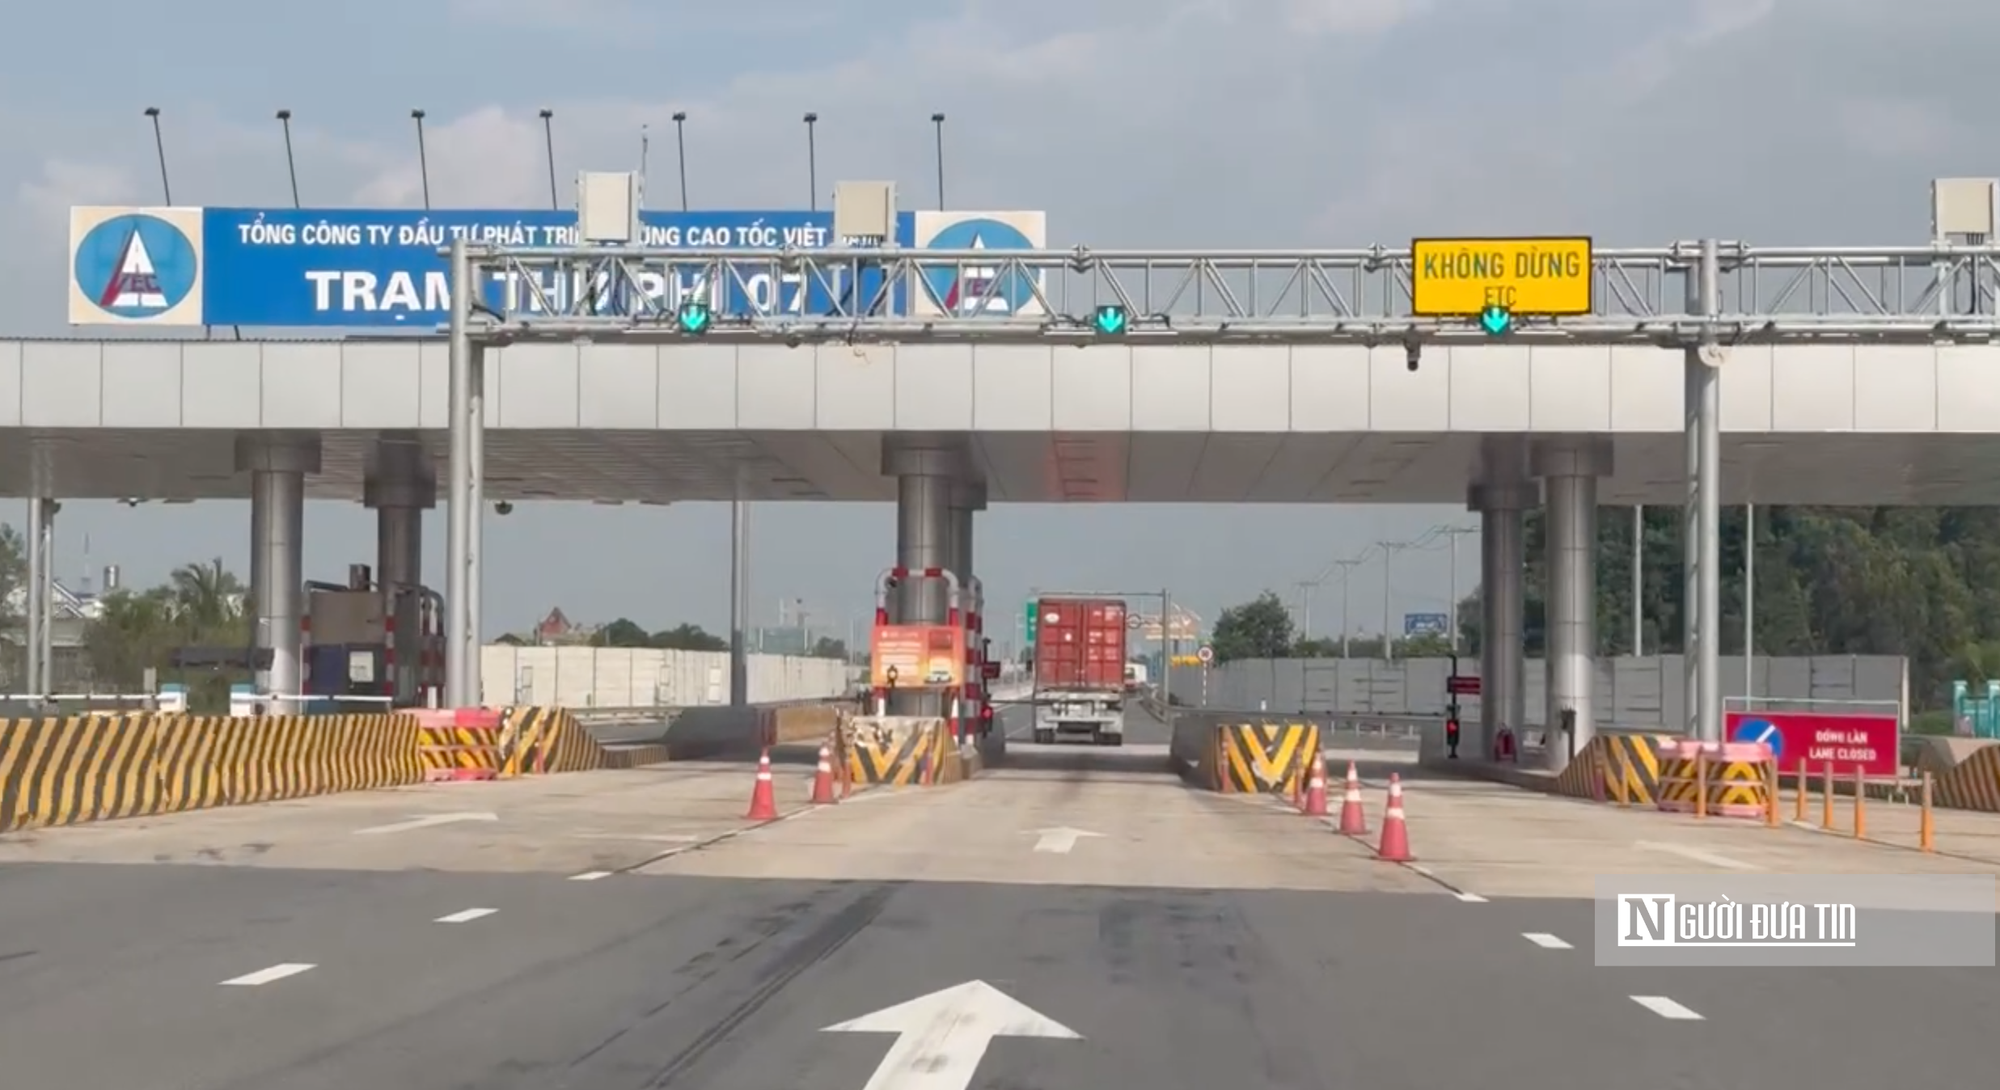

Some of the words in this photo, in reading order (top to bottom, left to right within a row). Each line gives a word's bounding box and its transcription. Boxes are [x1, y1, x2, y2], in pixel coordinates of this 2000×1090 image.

[238, 212, 296, 244] TỔNG
[302, 219, 361, 245] CÔNG
[367, 225, 394, 245] TY
[399, 216, 444, 245] ĐẦU
[484, 220, 538, 244] PHÁT
[686, 226, 731, 246] CAO
[736, 218, 777, 247] TỐC
[1423, 247, 1505, 279] KHÔNG
[1514, 246, 1580, 279] DỪNG
[305, 271, 452, 320] TRẠM
[747, 273, 807, 312] 07
[1484, 286, 1517, 307] ETC
[1808, 746, 1835, 760] LANE
[1837, 747, 1877, 761] CLOSED
